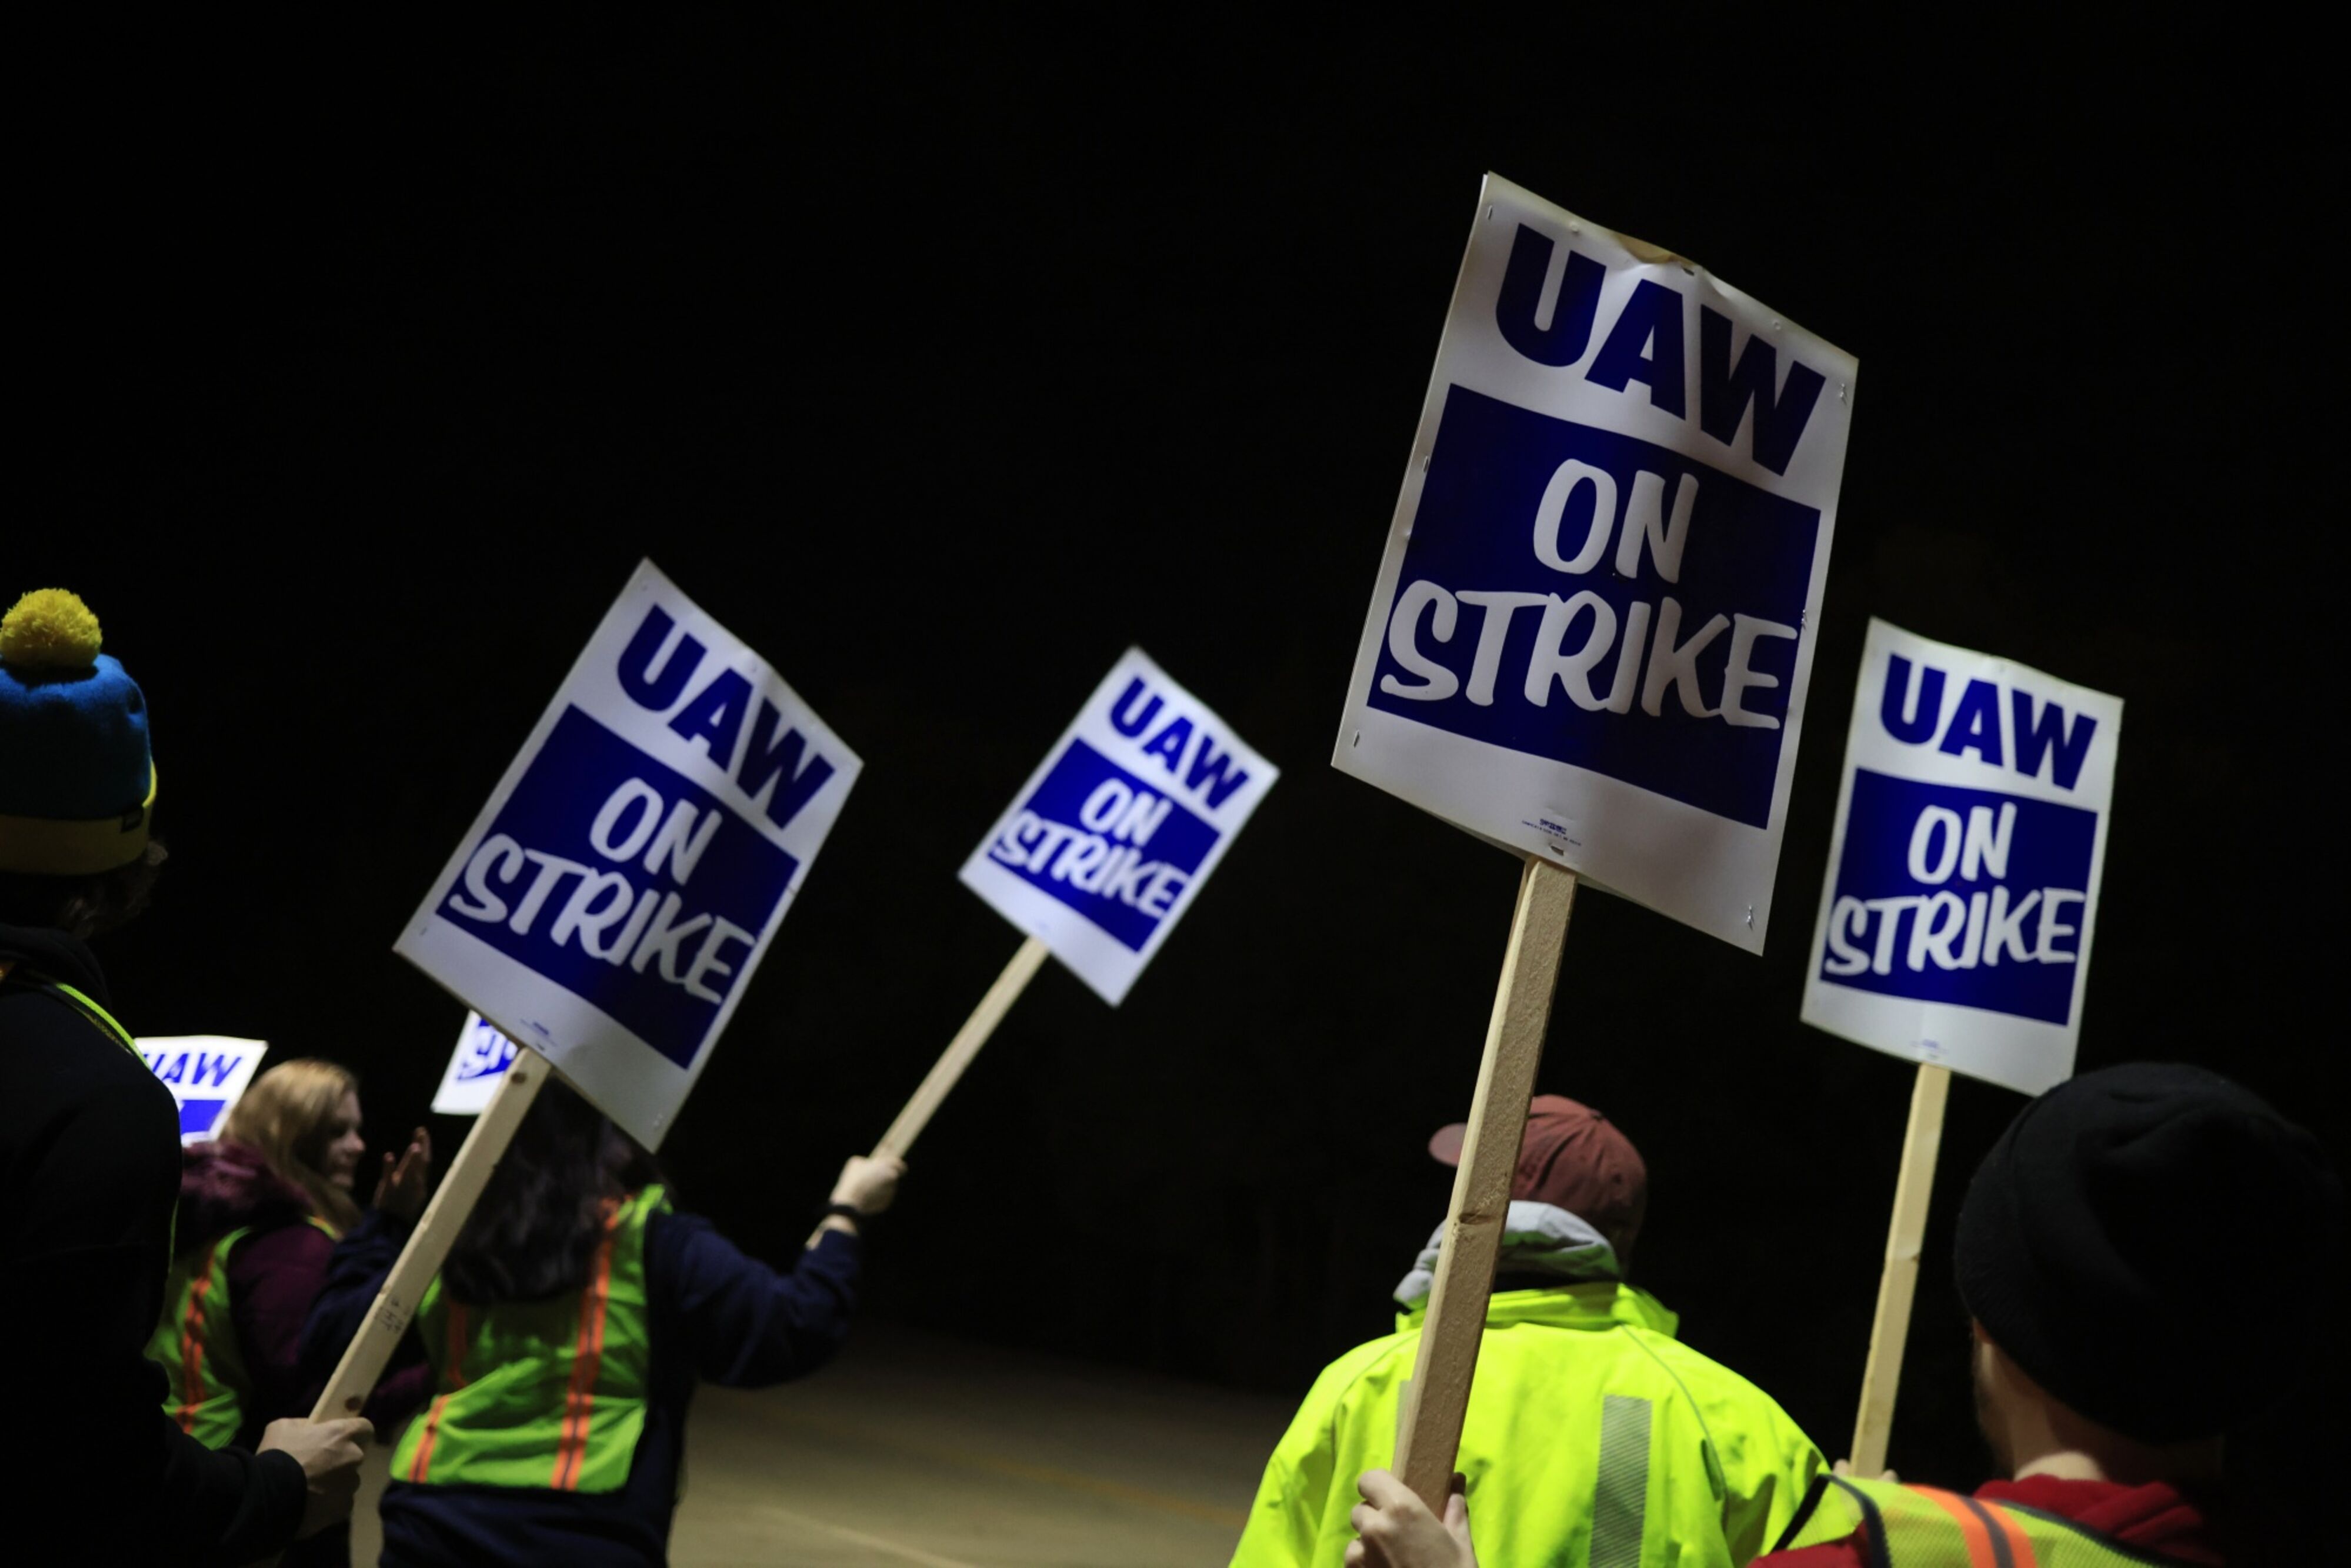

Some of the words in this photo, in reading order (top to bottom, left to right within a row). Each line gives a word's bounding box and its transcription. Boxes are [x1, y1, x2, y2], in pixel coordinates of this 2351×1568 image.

[1496, 223, 1826, 476] UAW
[1533, 458, 1699, 583] ON
[618, 604, 835, 829] UAW
[1379, 579, 1798, 729] STRIKE
[1111, 678, 1248, 809] UAW
[1882, 654, 2097, 789] UAW
[588, 776, 723, 886] ON
[992, 808, 1192, 922] STRIKE
[1079, 776, 1175, 848] ON
[1906, 800, 2018, 886] ON
[448, 832, 756, 1005] STRIKE
[1823, 885, 2087, 976] STRIKE
